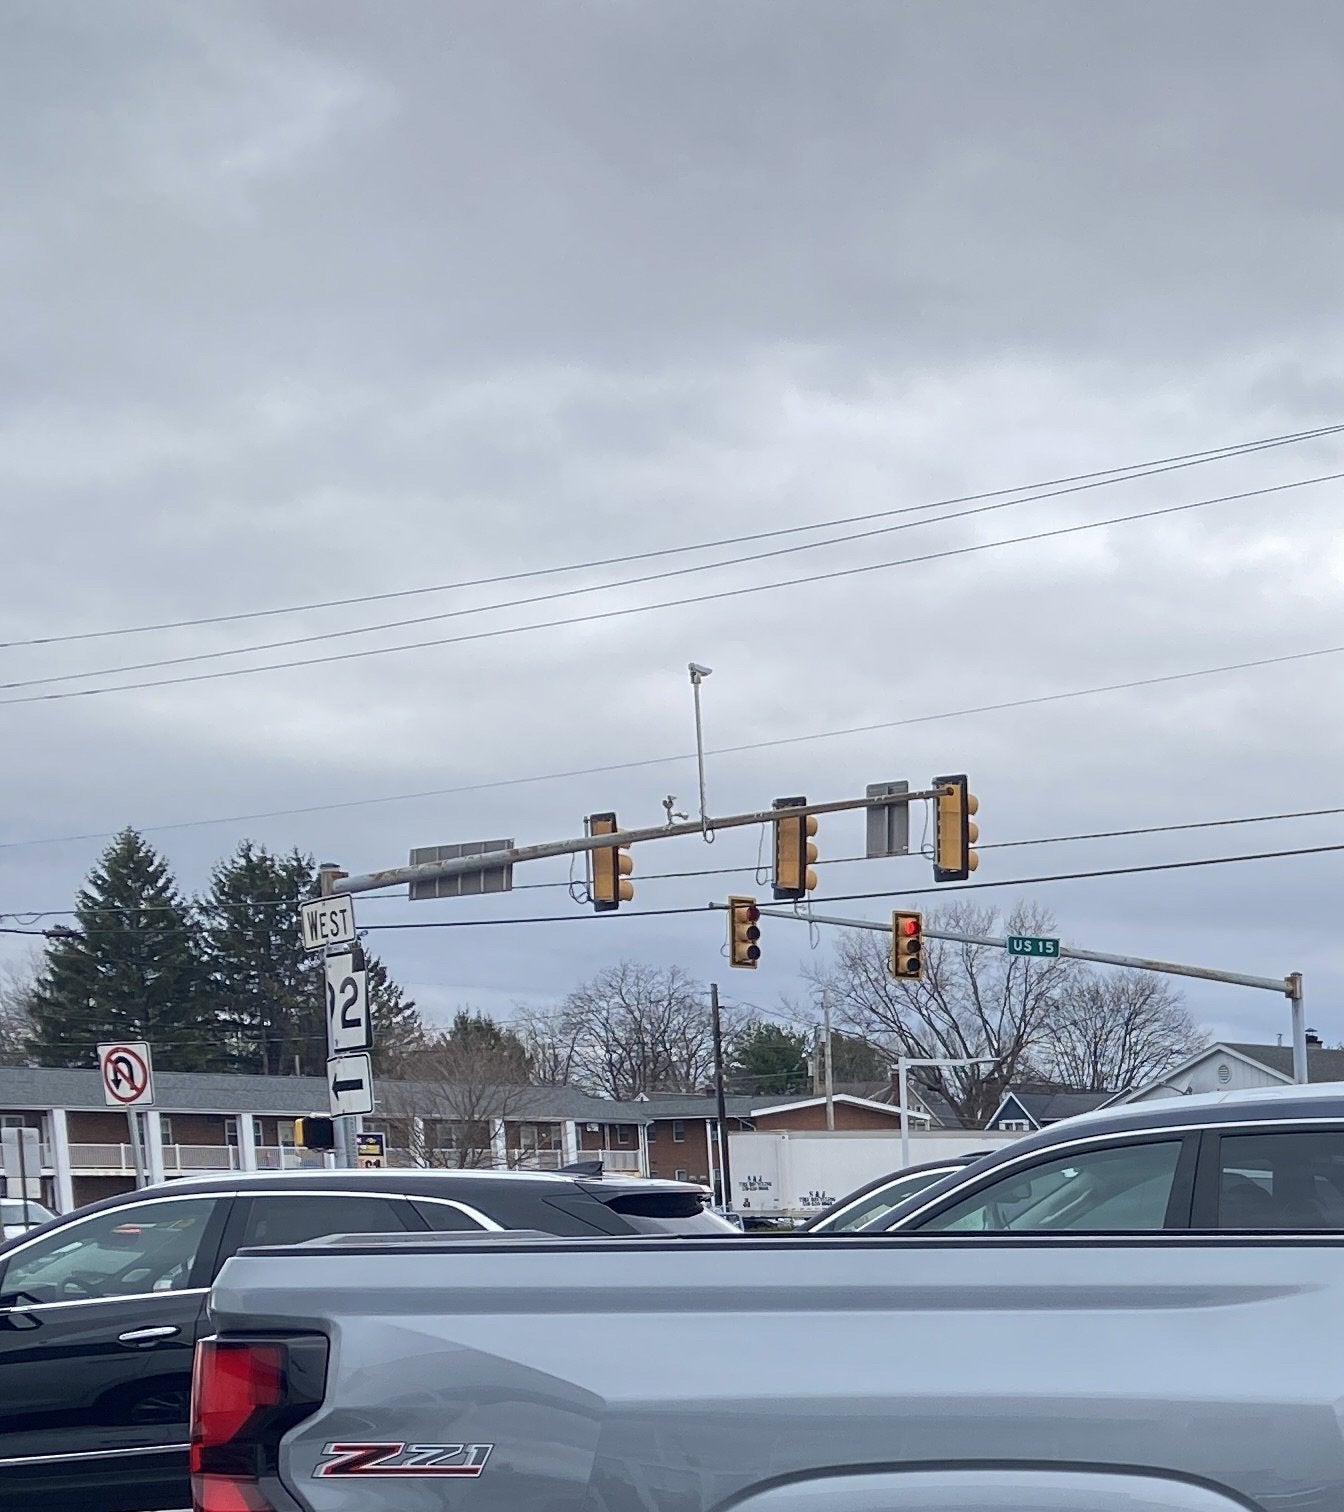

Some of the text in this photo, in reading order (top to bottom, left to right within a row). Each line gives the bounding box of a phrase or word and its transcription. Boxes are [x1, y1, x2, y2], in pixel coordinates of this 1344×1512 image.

[306, 908, 348, 941] WEST
[1013, 939, 1055, 954] US 15
[311, 1441, 495, 1479] Z71
